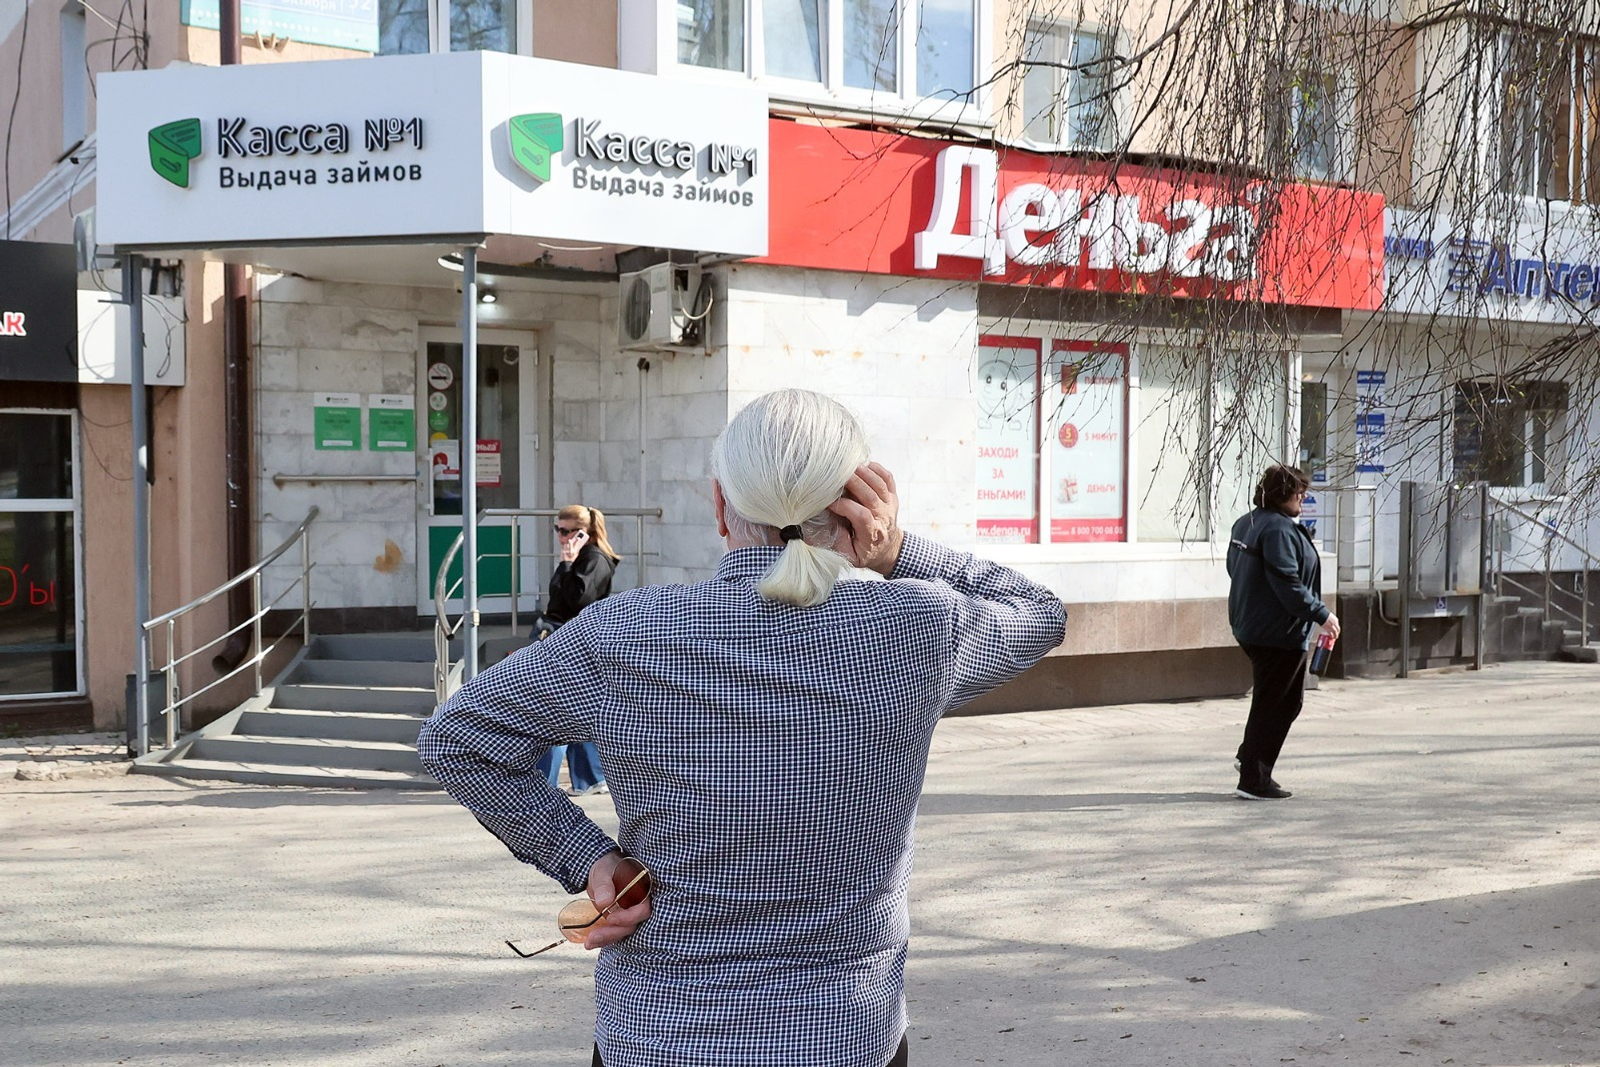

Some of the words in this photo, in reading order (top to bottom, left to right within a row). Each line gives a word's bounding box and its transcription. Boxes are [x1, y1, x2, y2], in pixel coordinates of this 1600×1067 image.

[218, 117, 350, 158] Касса
[365, 117, 423, 151] №1
[575, 117, 696, 169] Касса
[709, 142, 758, 177] №1
[219, 166, 317, 190] Выдача
[326, 160, 422, 184] займов
[573, 167, 665, 197] Выдача
[672, 180, 754, 207] займов
[914, 145, 1256, 281] Деньга
[1483, 243, 1600, 302] Апте
[0, 312, 27, 336] К
[977, 447, 1019, 460] ЗАХОДИ
[992, 467, 1005, 480] ЗА
[1086, 484, 1117, 494] ДЕНЬГИ
